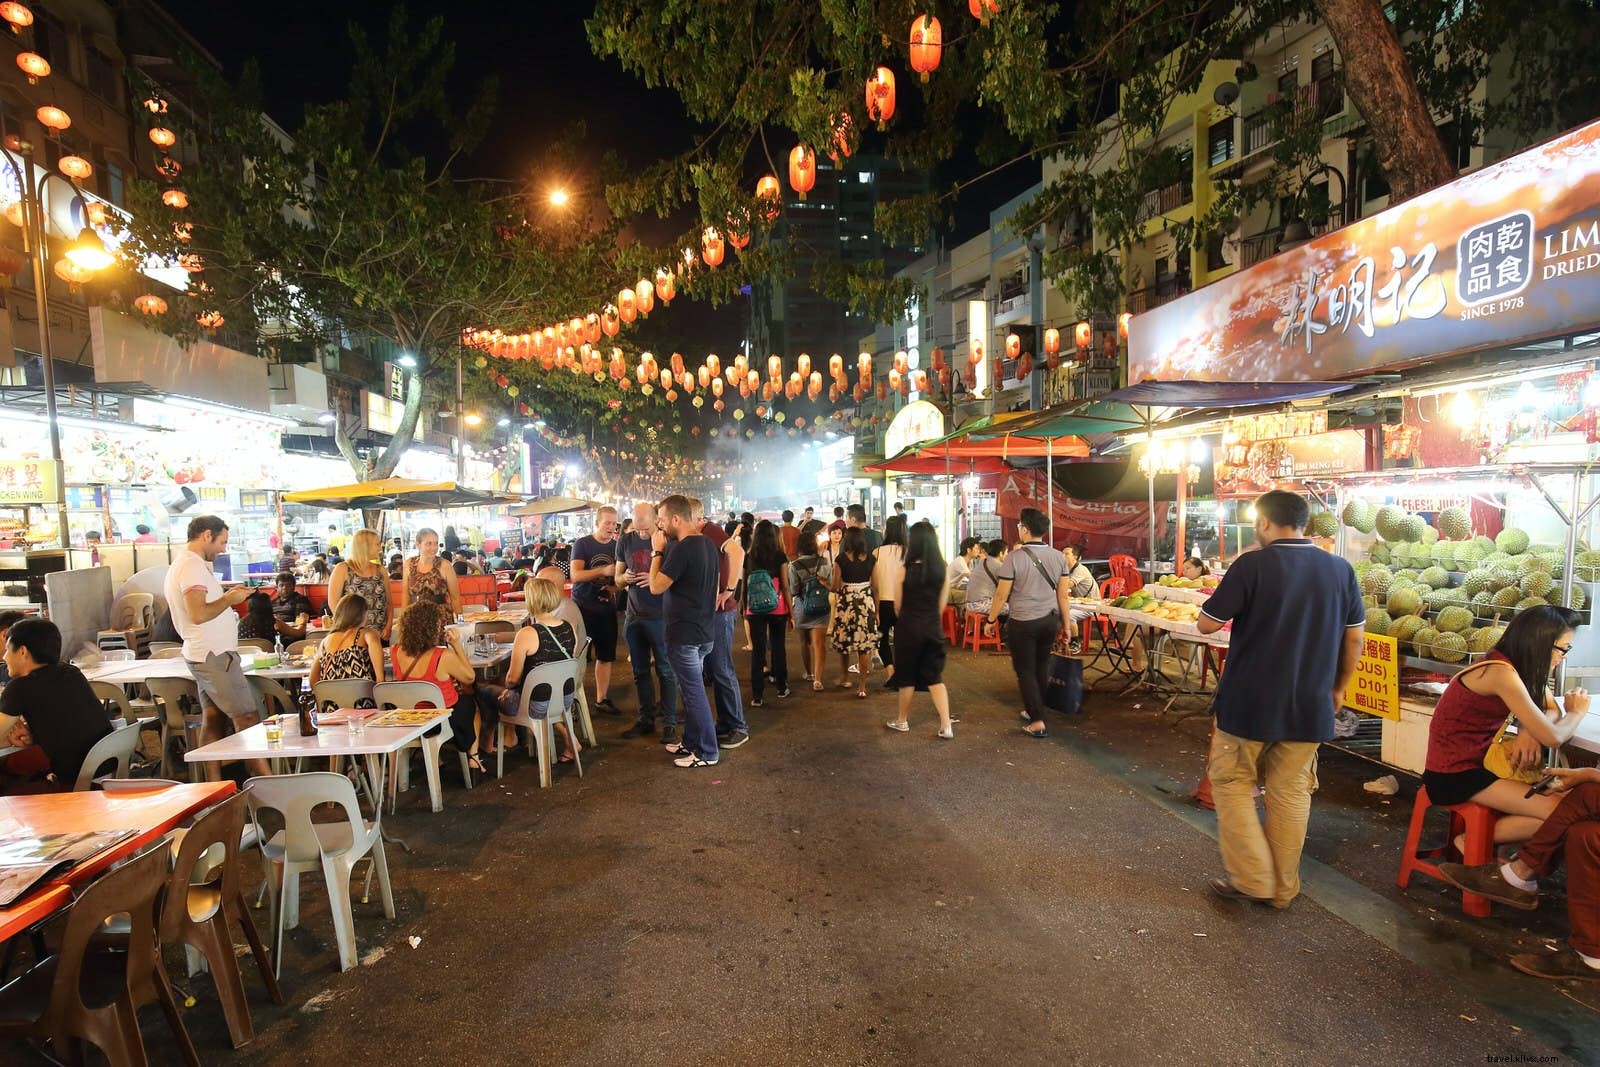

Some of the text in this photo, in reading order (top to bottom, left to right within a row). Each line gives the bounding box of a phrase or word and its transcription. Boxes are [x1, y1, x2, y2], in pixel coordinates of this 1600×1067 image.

[1543, 220, 1600, 260] LIM
[1542, 252, 1600, 280] DRIED
[1460, 296, 1525, 321] SINCE 1978
[1358, 677, 1388, 695] D101
